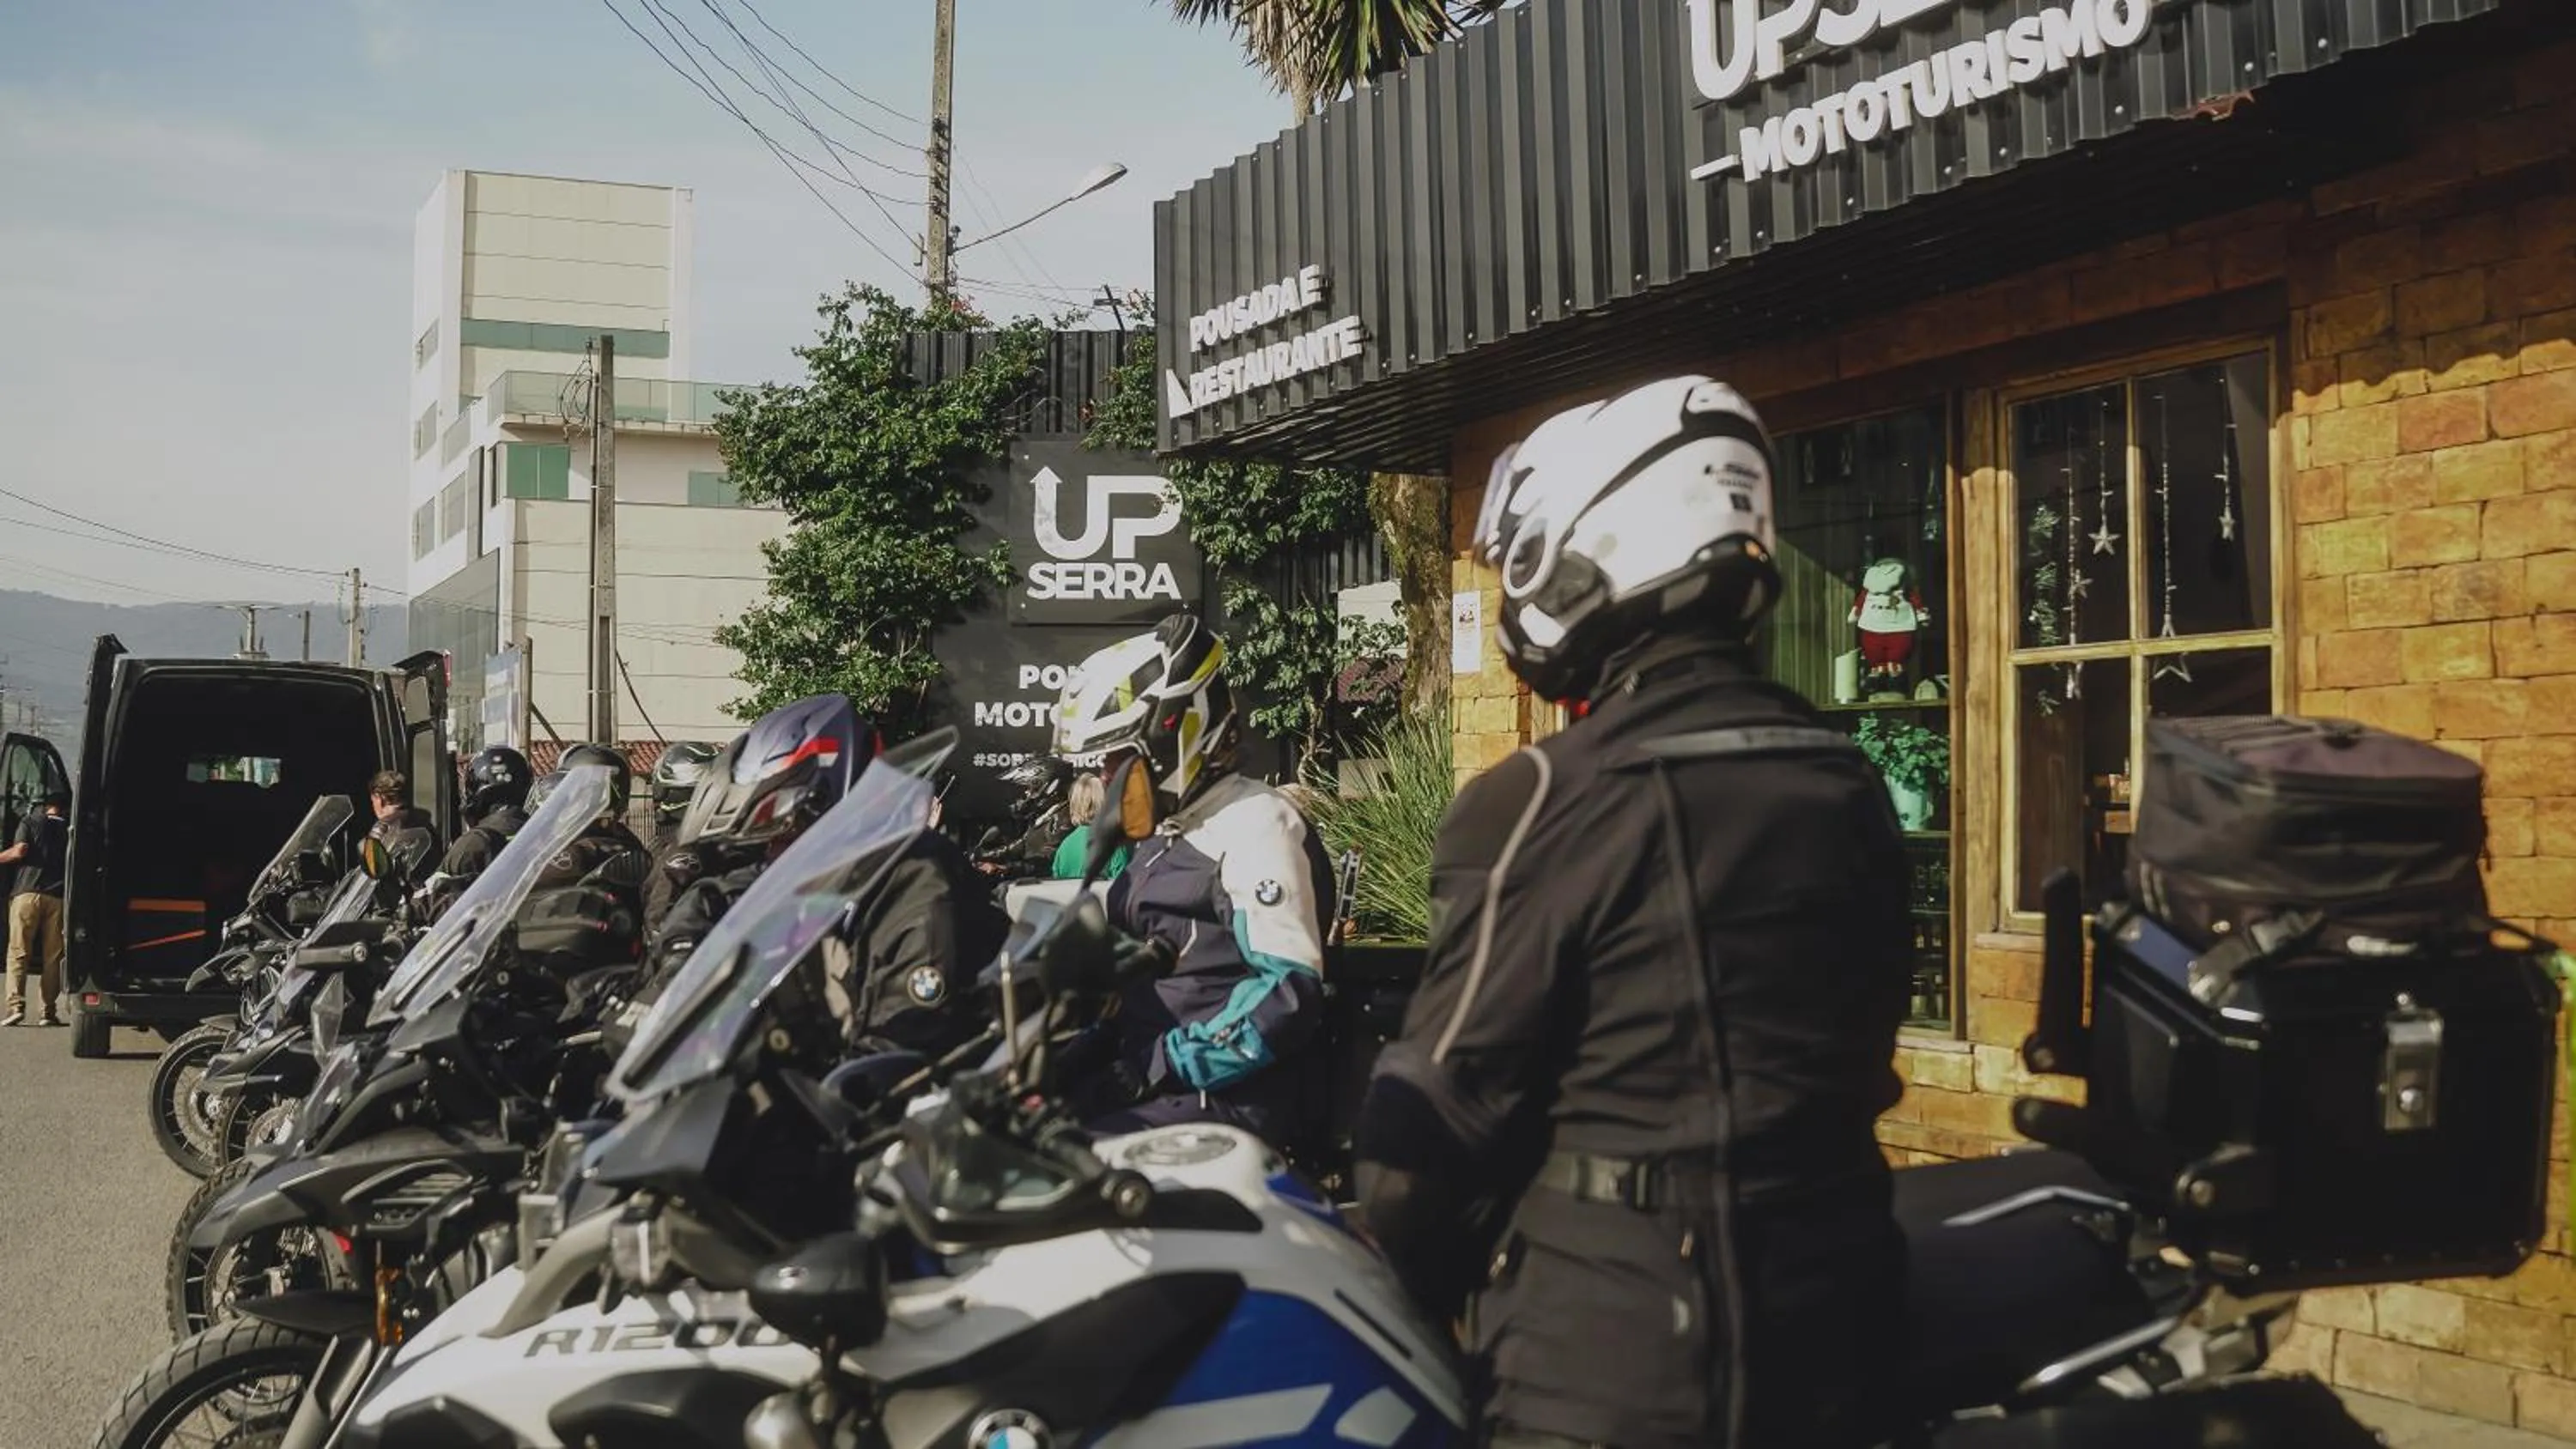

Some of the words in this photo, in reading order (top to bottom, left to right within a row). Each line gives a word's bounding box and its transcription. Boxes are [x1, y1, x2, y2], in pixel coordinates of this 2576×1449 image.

[1740, 0, 2150, 182] MOTOTURISMO
[1189, 277, 1302, 353] POUSADA
[1300, 264, 1322, 307] E
[1189, 315, 1363, 409] RESTAURANTE
[1030, 466, 1183, 560] UP
[1026, 562, 1182, 600] SERRA
